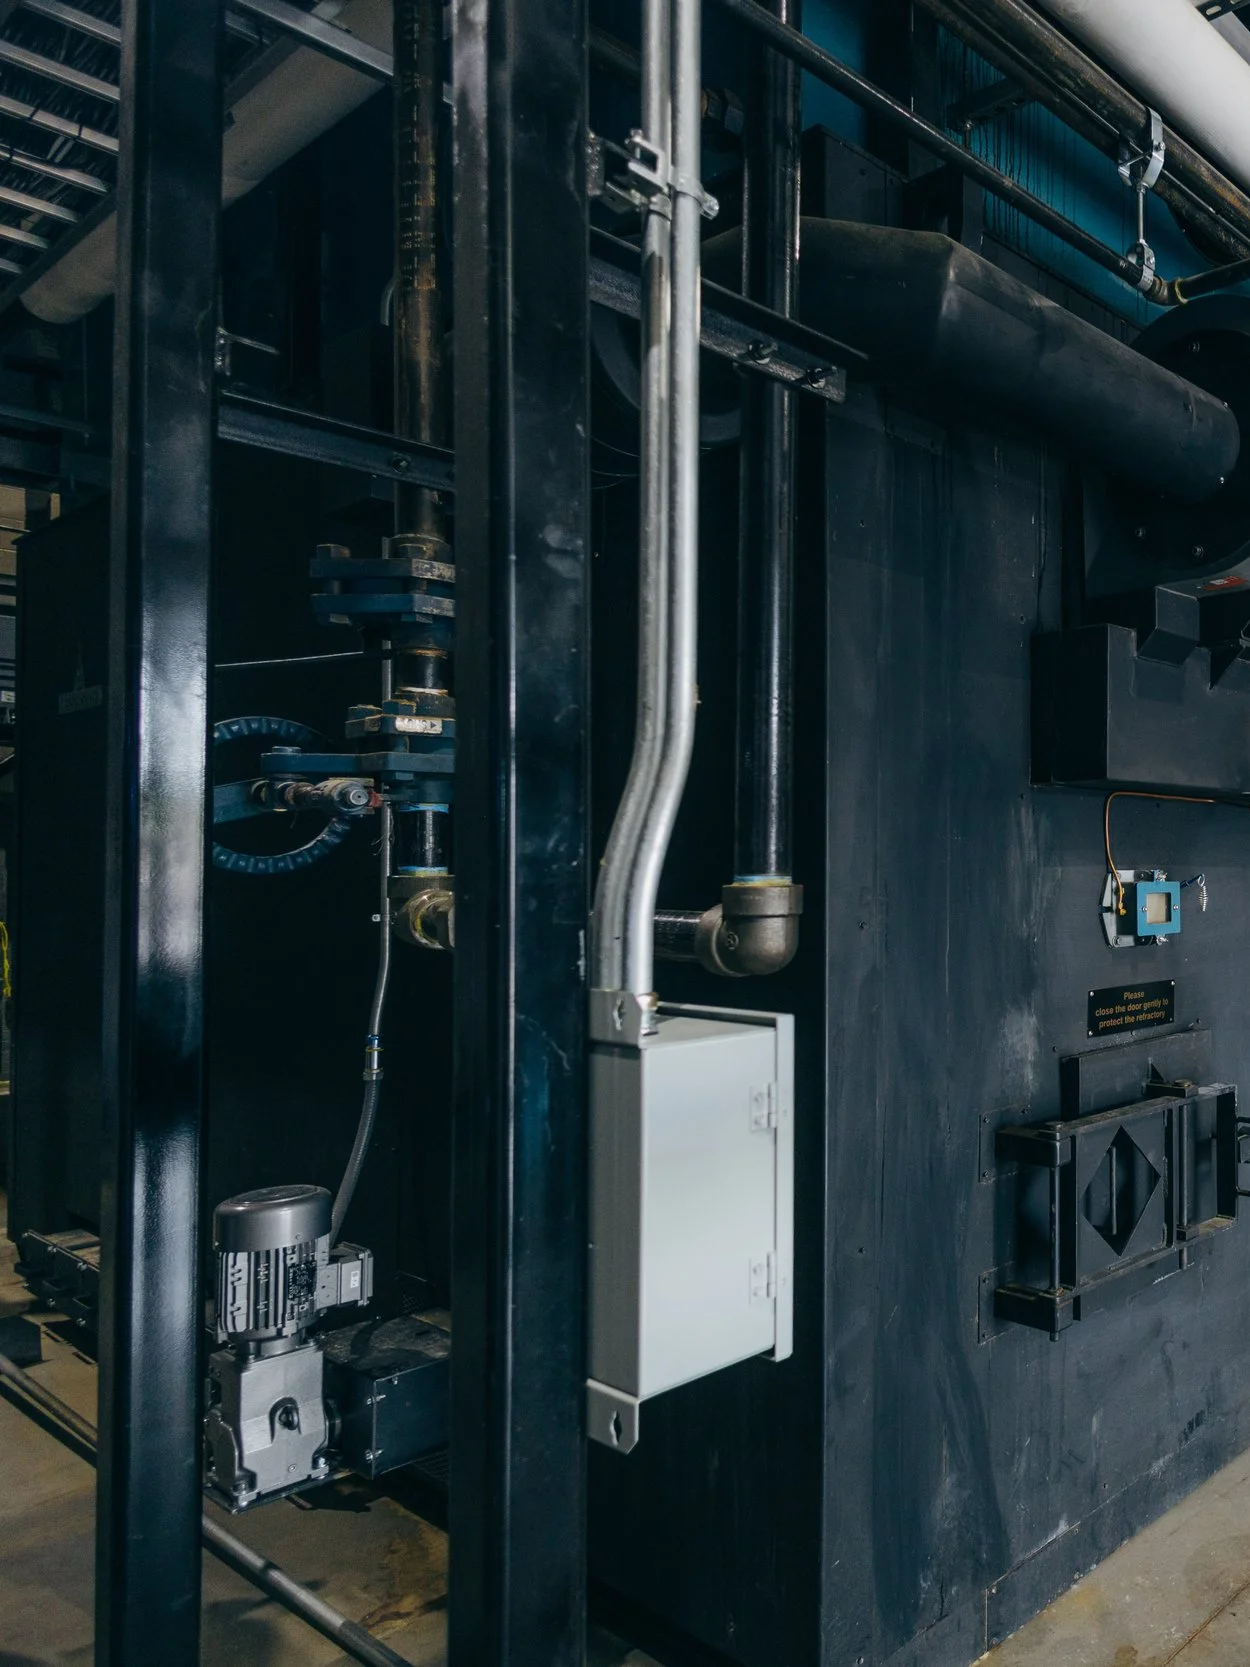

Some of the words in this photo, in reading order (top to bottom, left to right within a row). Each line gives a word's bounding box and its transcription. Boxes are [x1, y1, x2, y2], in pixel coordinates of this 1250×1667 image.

[1123, 991, 1145, 1000] Please
[1095, 1007, 1114, 1017] close
[1115, 1004, 1126, 1013] the
[1127, 1002, 1142, 1011] door
[1143, 999, 1162, 1011] gently
[1162, 998, 1169, 1006] to
[1098, 1016, 1123, 1030] protect
[1124, 1015, 1135, 1024] the
[1136, 1010, 1166, 1021] refractory
